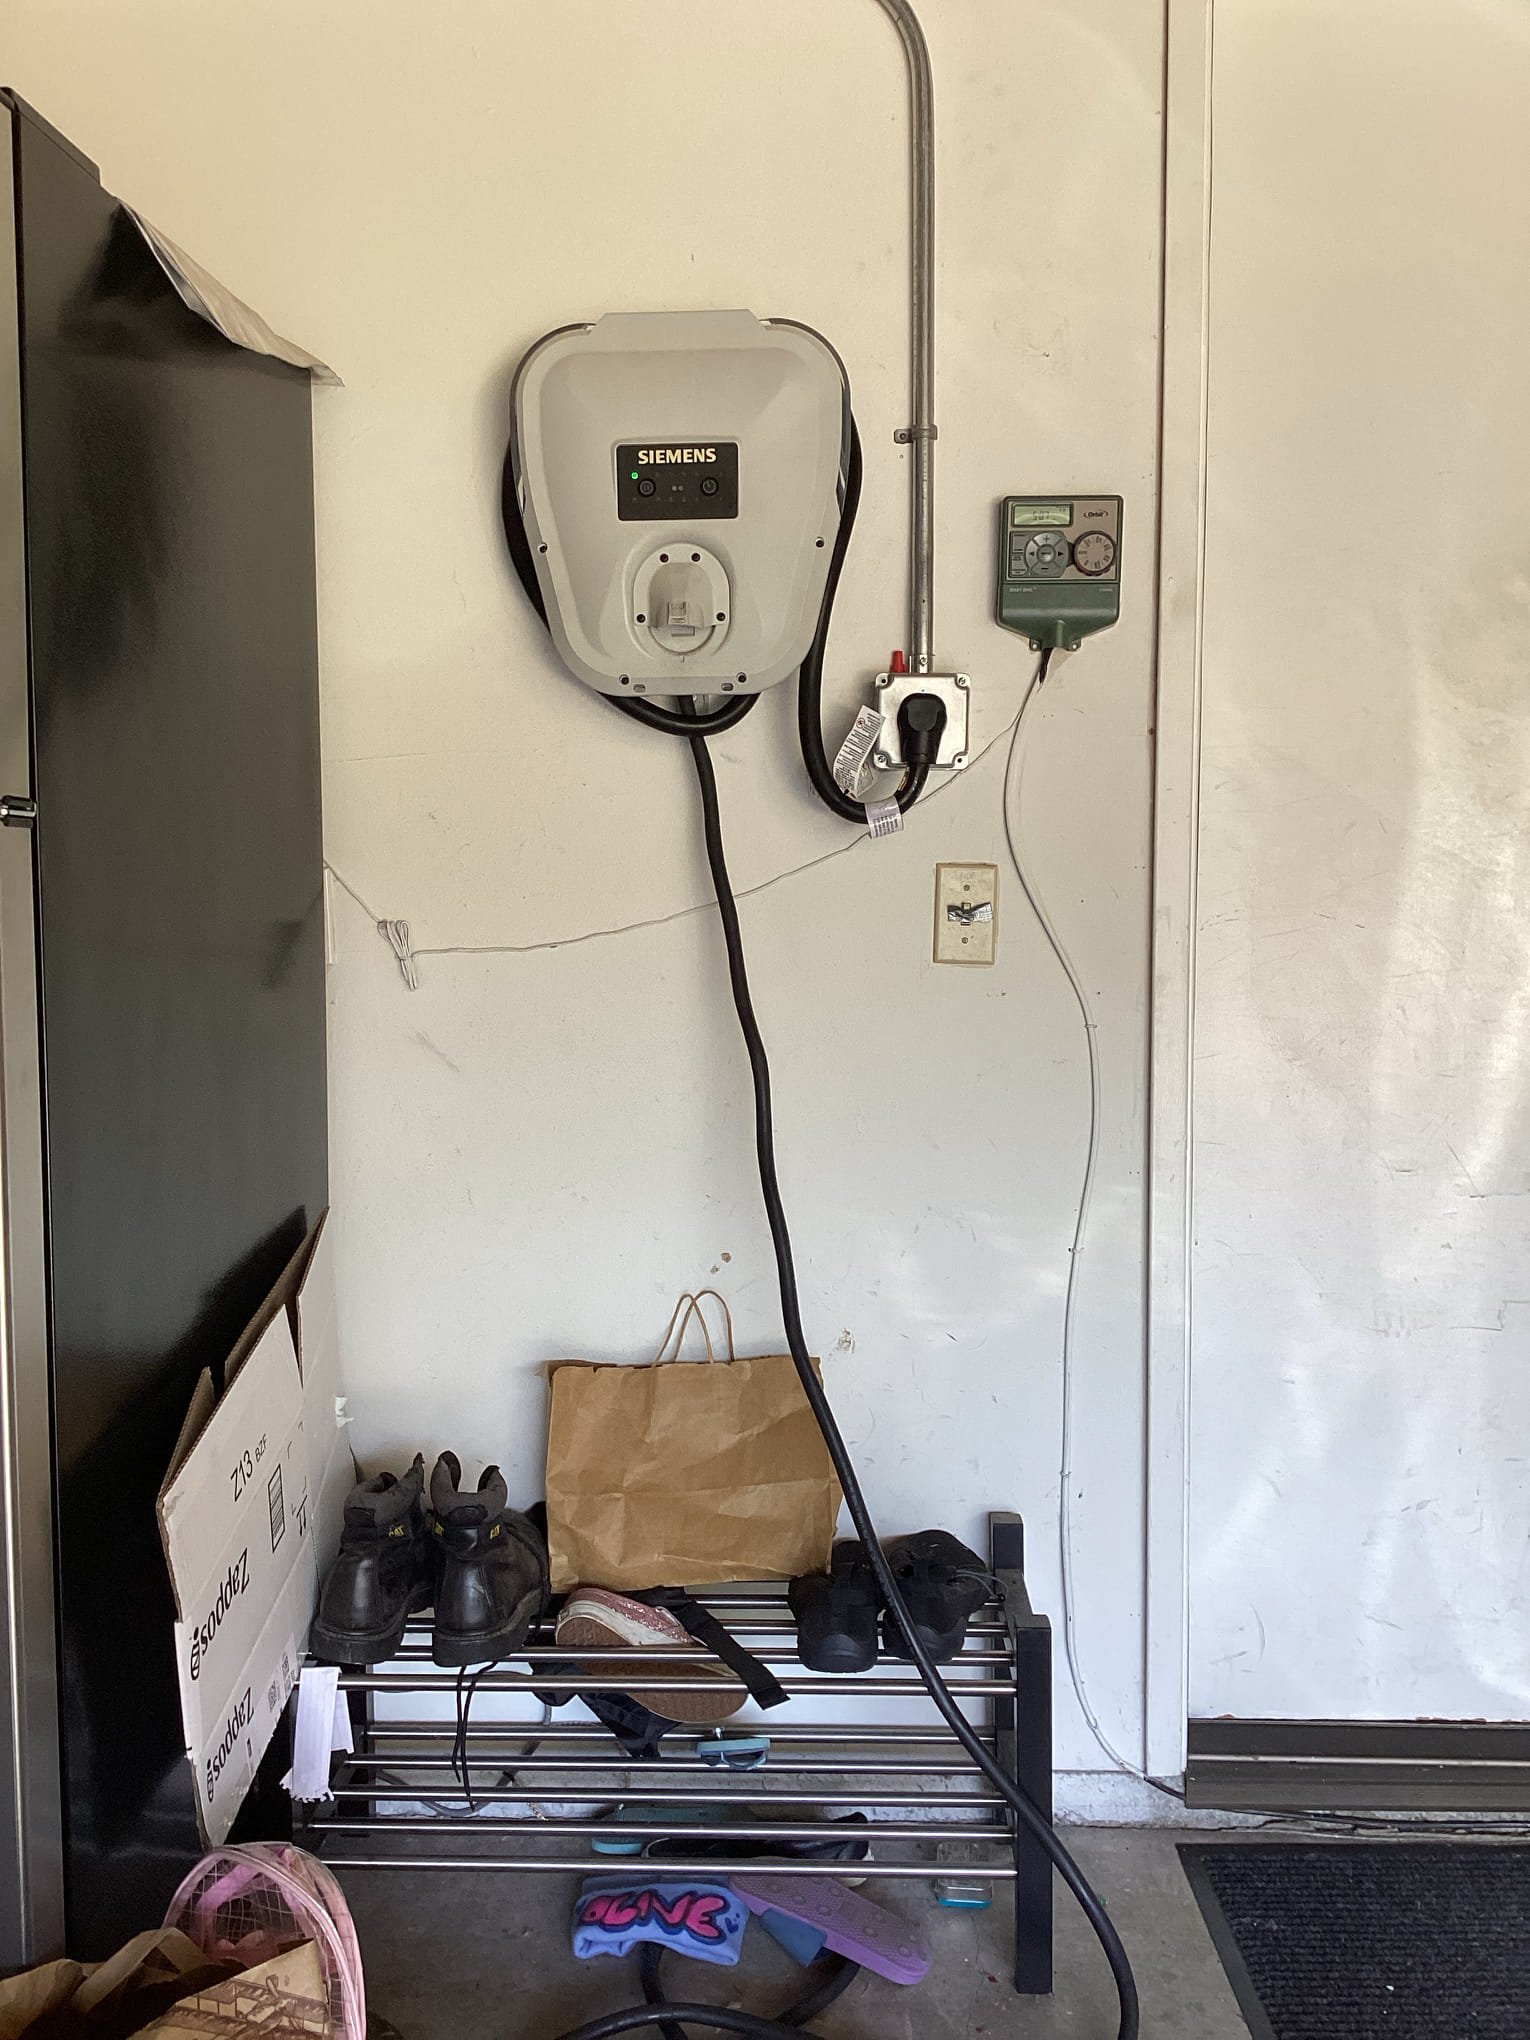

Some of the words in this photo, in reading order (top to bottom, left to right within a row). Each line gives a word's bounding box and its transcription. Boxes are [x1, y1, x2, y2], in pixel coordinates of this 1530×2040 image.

[638, 448, 716, 465] SIEMENS
[230, 1448, 253, 1503] Z13
[254, 1433, 268, 1464] BZF
[388, 1525, 404, 1537] CAT
[490, 1524, 500, 1540] CAT
[200, 1548, 250, 1657] Zappos
[212, 1686, 255, 1774] Zappos
[580, 1889, 730, 1945] OLIVE
